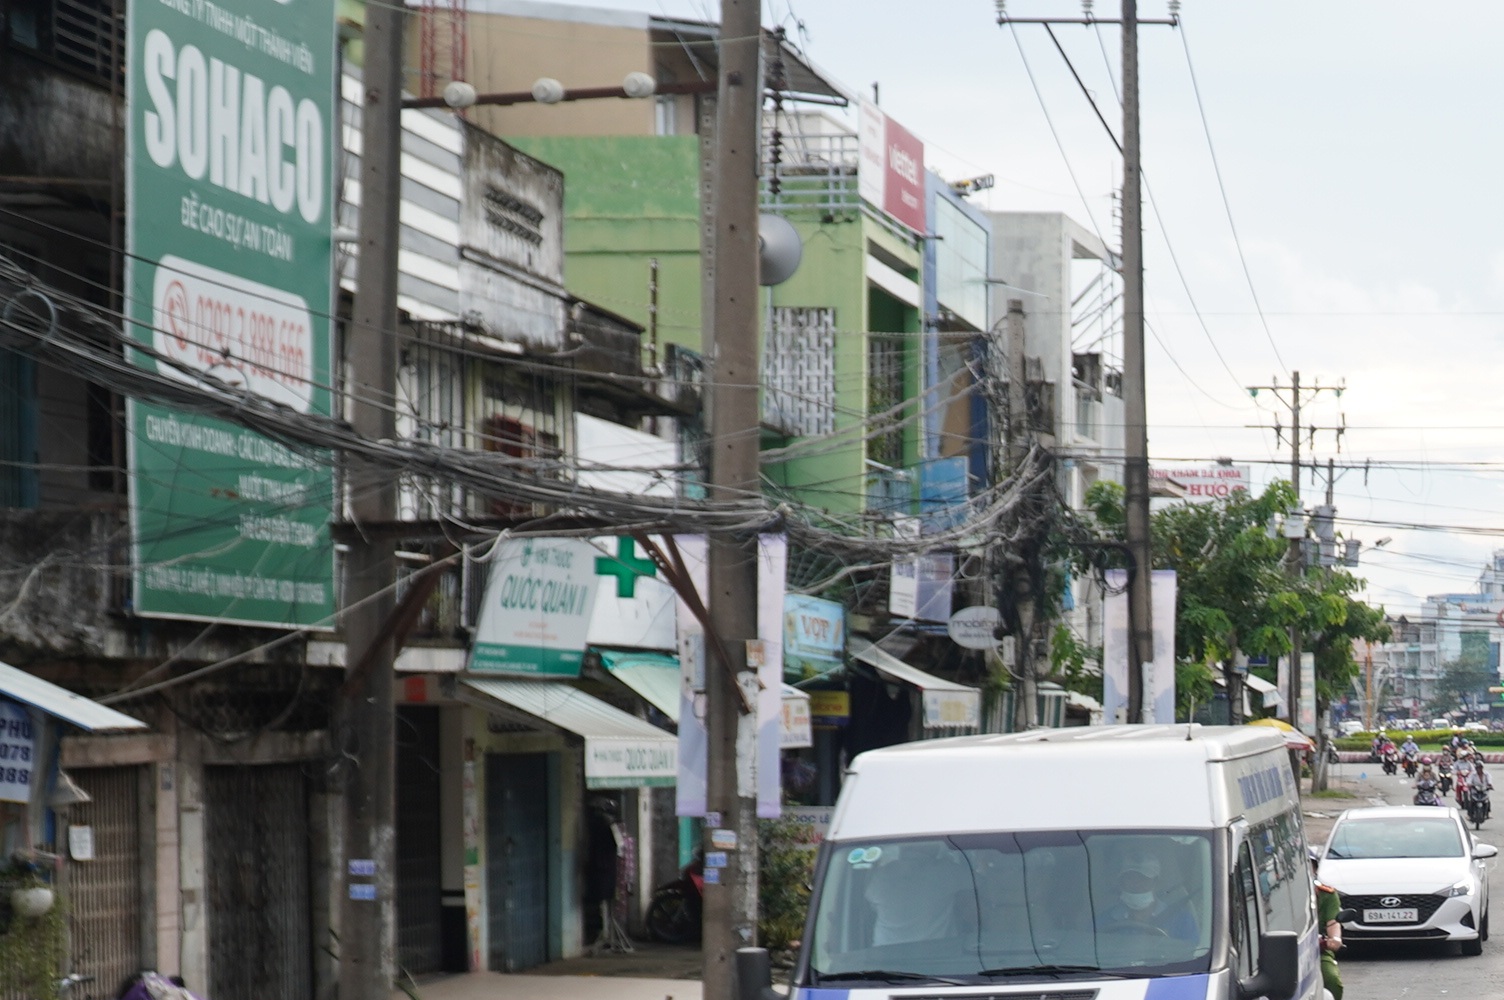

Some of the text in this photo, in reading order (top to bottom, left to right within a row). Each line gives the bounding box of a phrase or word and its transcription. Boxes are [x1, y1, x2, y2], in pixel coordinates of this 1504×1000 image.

[144, 28, 324, 224] SOHACO
[181, 189, 293, 262] ĐỀ CAO SỰ AN TOÀN
[146, 413, 180, 447] CHUYÊN
[0, 766, 30, 786] 88
